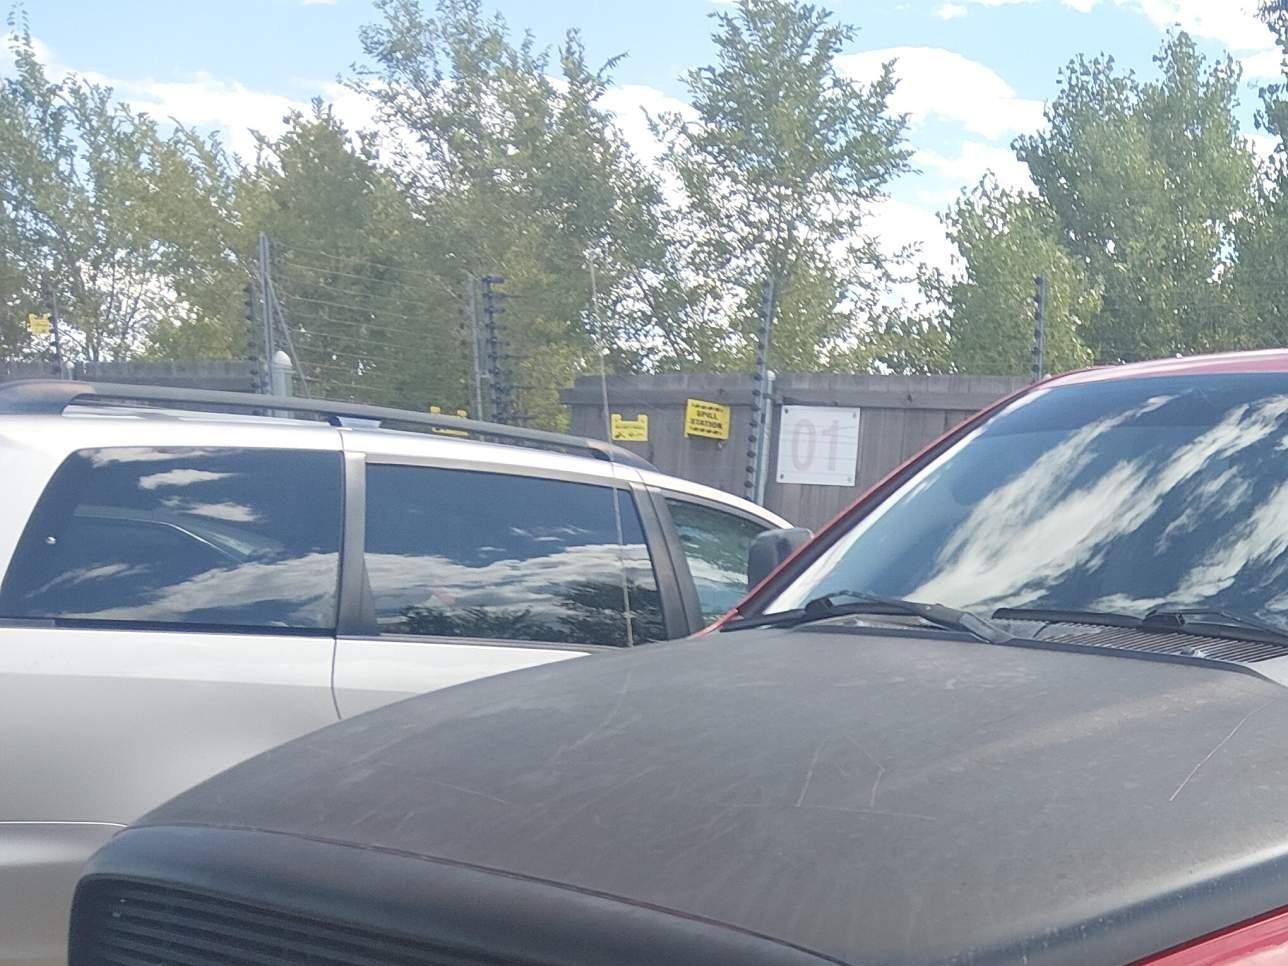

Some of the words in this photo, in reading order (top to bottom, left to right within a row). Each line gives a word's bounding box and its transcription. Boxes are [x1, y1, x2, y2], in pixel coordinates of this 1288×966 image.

[696, 410, 719, 420] SPILL
[690, 418, 723, 429] STATION
[791, 418, 839, 472] 01
